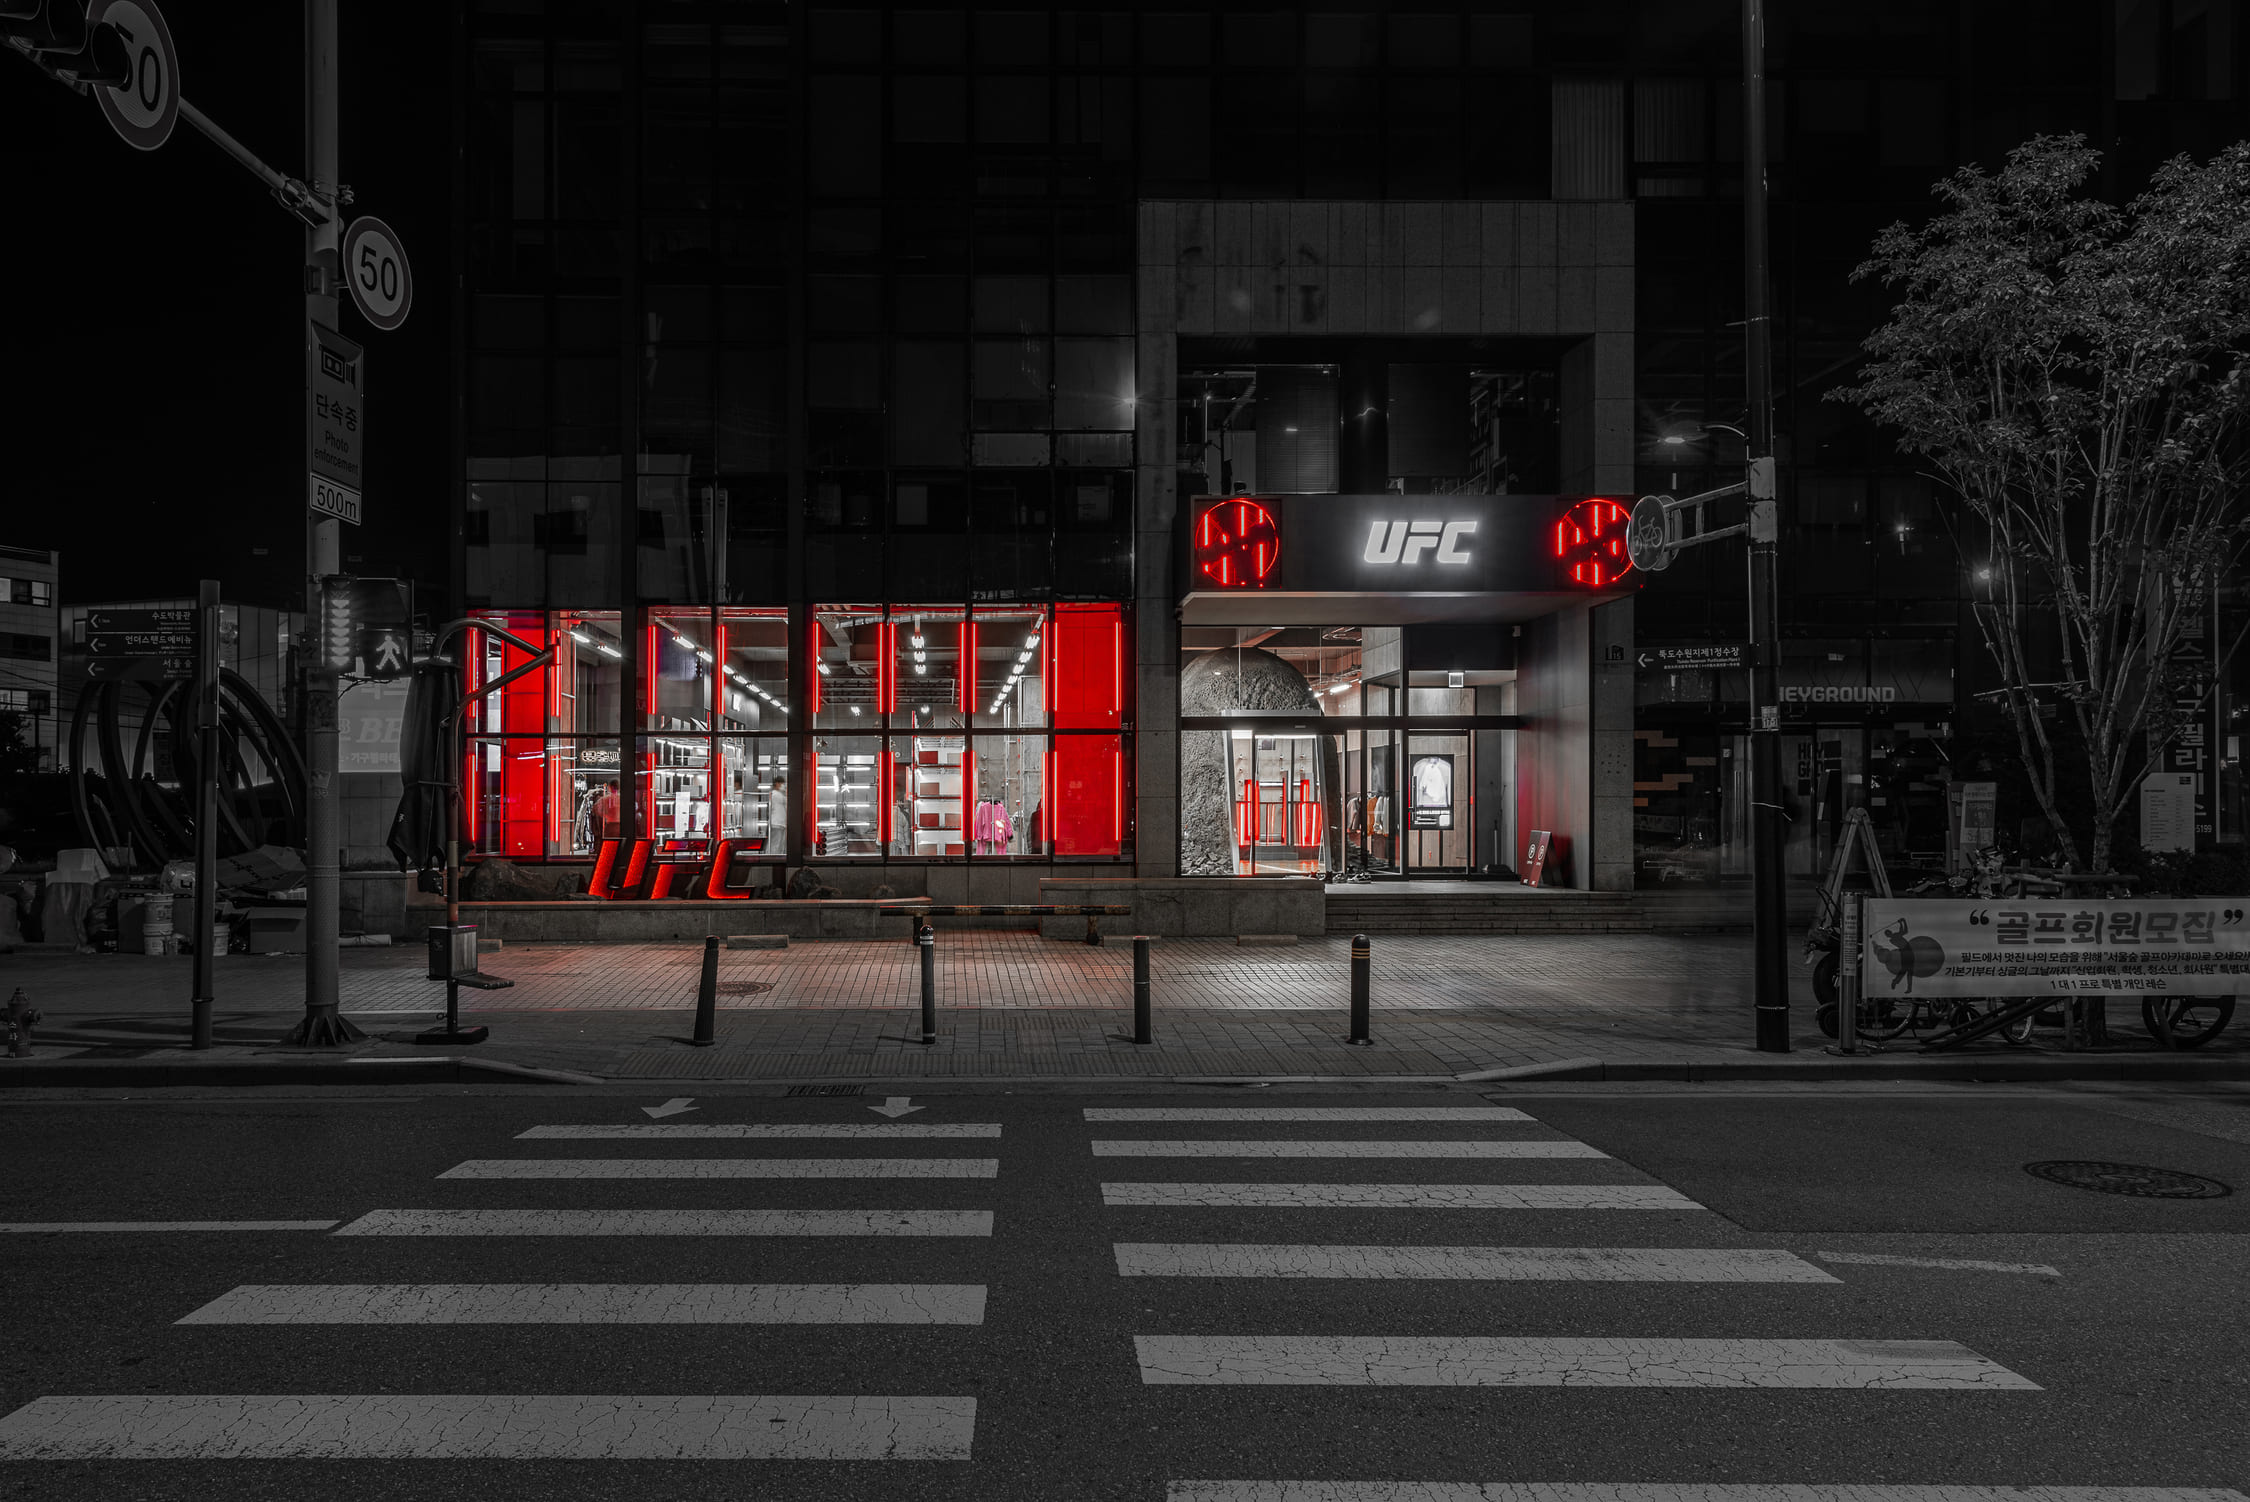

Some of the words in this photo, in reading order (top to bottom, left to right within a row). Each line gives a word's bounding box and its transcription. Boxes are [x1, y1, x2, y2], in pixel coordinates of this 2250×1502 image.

[360, 244, 398, 302] 50
[316, 393, 358, 432] 단속중
[325, 430, 350, 454] Photo
[314, 448, 359, 477] enforcement
[317, 485, 357, 519] 500m
[1364, 521, 1478, 564] UFC
[151, 610, 192, 621] 수도박물관
[588, 838, 766, 900] UFC
[1945, 966, 1996, 977] 기본기부터
[1998, 966, 2027, 977] 싱글의
[2028, 966, 2071, 977] 그날까지
[1961, 952, 2002, 963] 필드에서
[2004, 952, 2025, 963] 멋진
[2027, 952, 2047, 963] 나의
[2048, 952, 2079, 963] 모습을
[2081, 952, 2102, 963] 위해
[2078, 979, 2102, 989] 프로
[2102, 978, 2123, 990] 특별
[2123, 978, 2145, 990] 개인
[2145, 978, 2167, 990] 레슨
